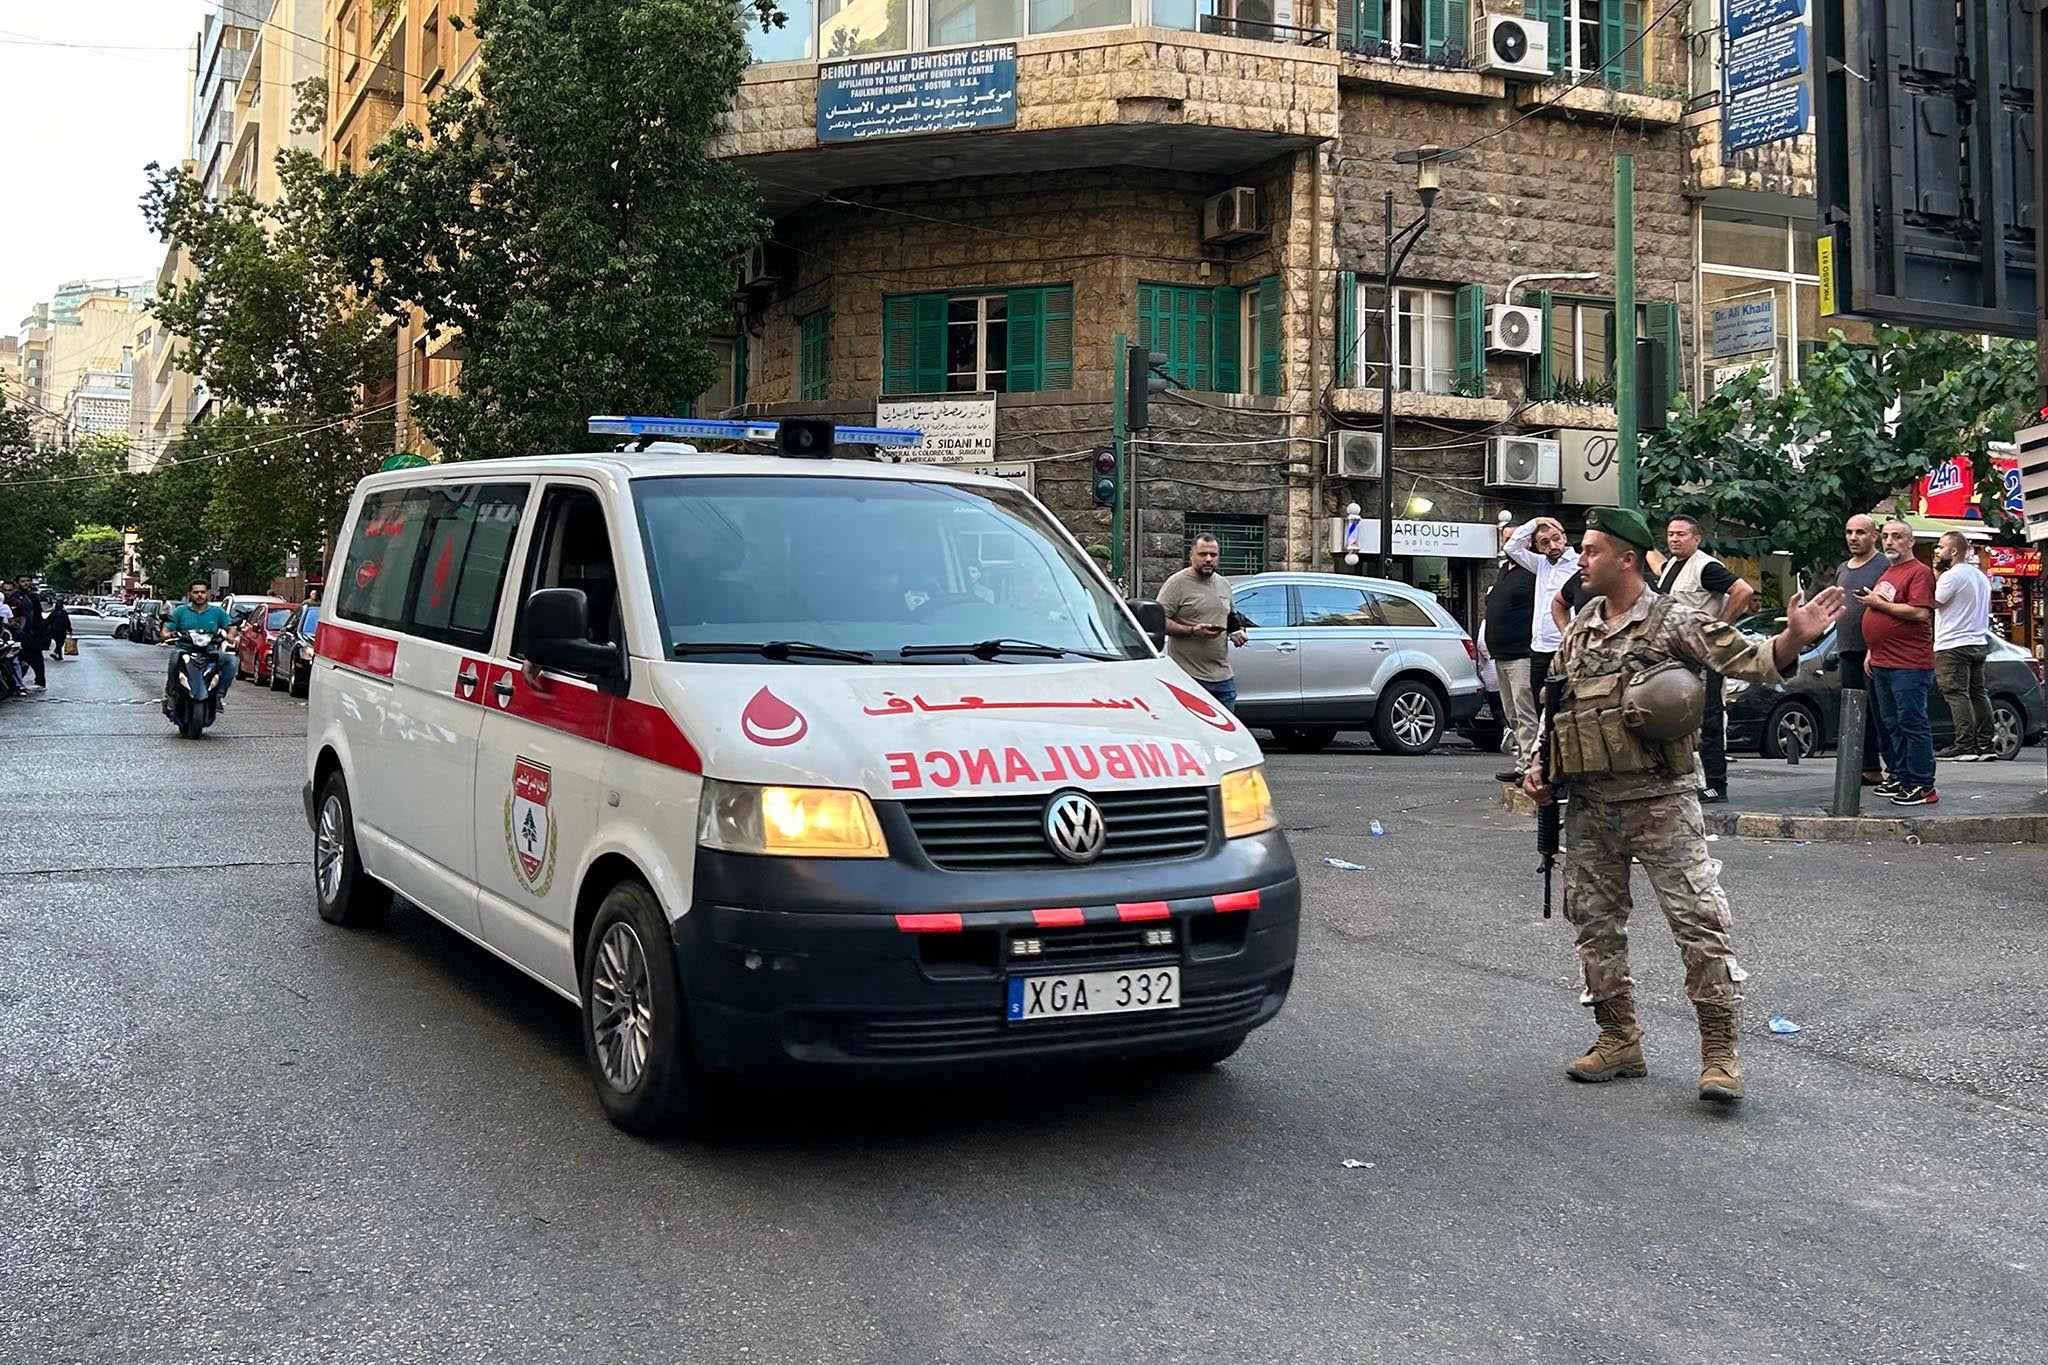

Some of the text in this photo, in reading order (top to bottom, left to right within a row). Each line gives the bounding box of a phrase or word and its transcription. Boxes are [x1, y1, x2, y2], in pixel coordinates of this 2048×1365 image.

[821, 47, 1014, 80] BEIRUT IMPLANT DENTISTRY CENTRE
[838, 64, 994, 89] AFFILIATED TO THE IMPLANT DENTISTRY CENTRE
[851, 87, 884, 98] FAULKNER
[885, 84, 916, 95] HOSPITAL
[924, 80, 951, 90] BOSTON
[960, 77, 980, 87] U.S.A.
[825, 88, 1012, 119] مركز بيروت لغرس الاسنان
[944, 109, 965, 119] مركز
[1716, 301, 1771, 322] Dr. Ali Khalil
[918, 449, 954, 457] COLORECTAL
[959, 448, 986, 456] SURGEON
[938, 439, 972, 449] SIDANI
[1928, 462, 1960, 490] 24h
[1393, 523, 1460, 538] ARFOUSH
[1405, 539, 1439, 547] salon
[863, 690, 1160, 720] إسعاف
[1029, 972, 1173, 1014] XGA 332
[1012, 1003, 1020, 1013] S
